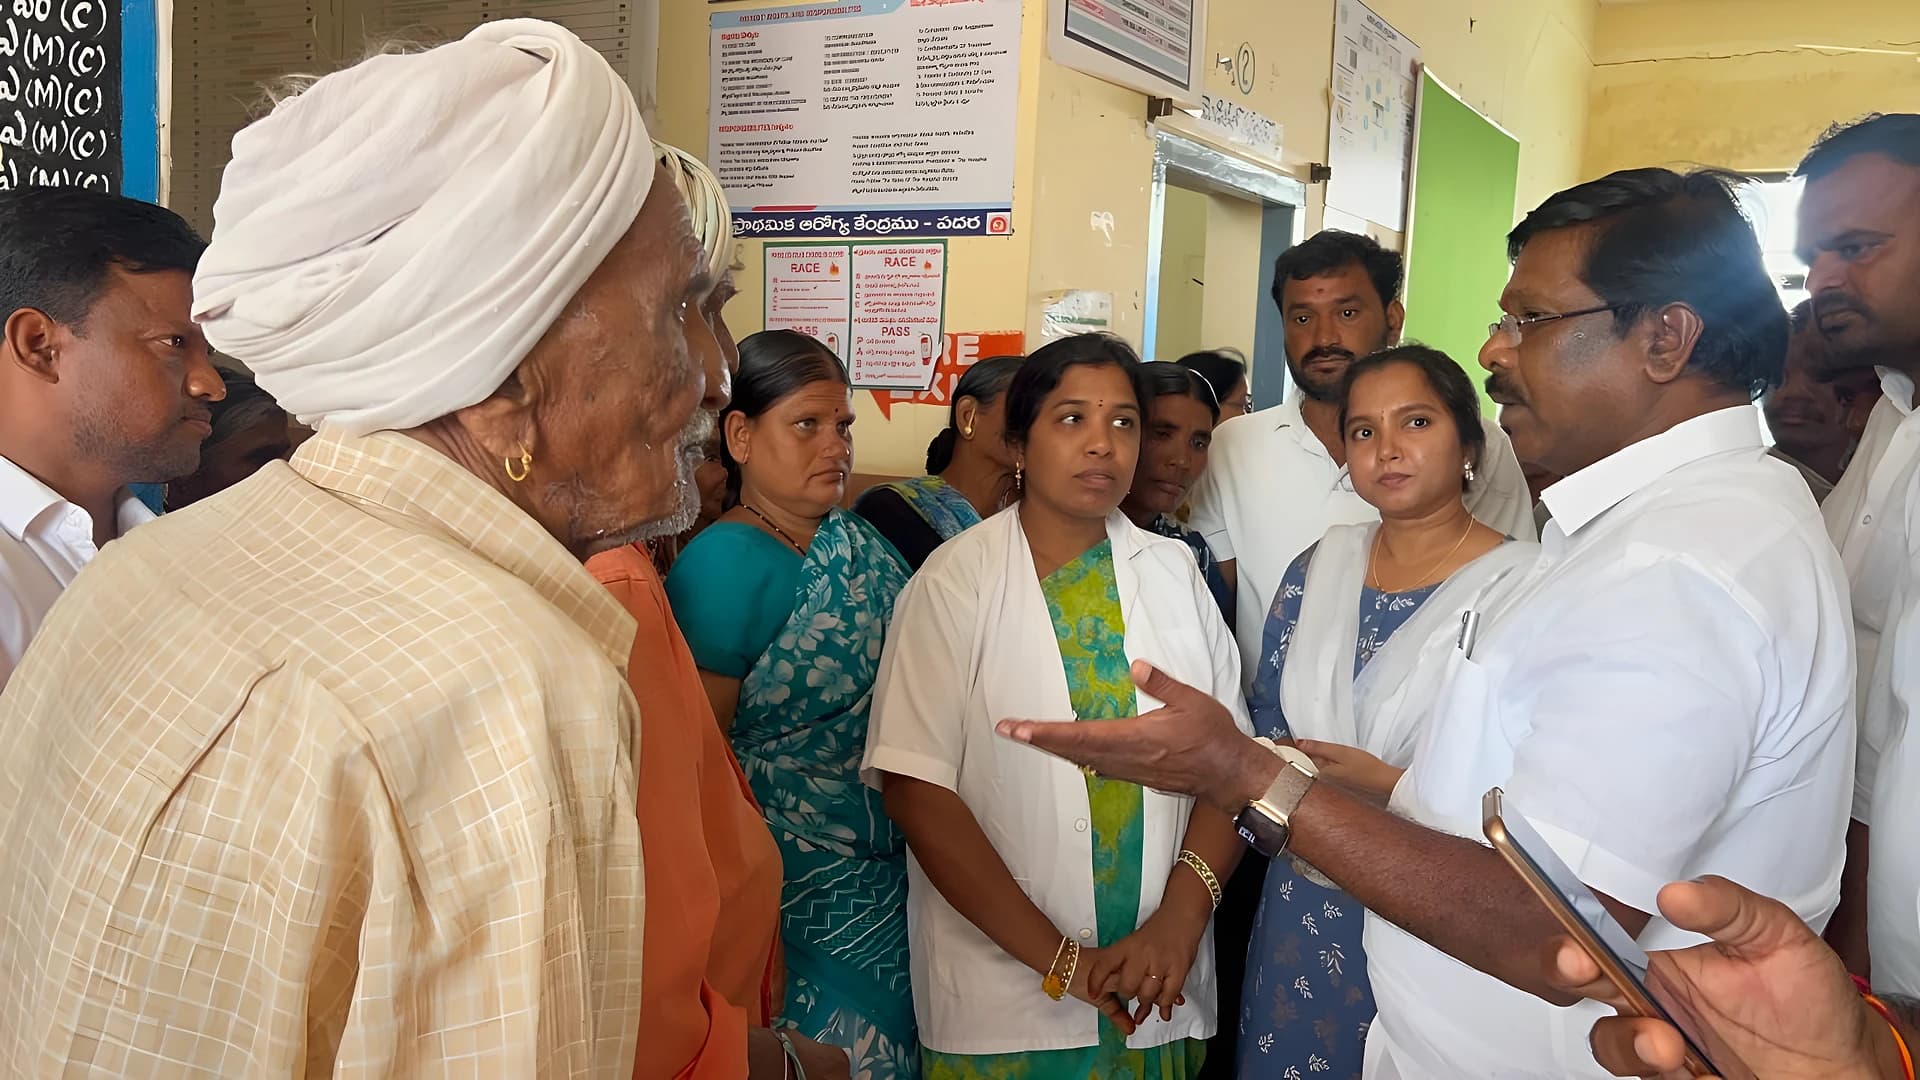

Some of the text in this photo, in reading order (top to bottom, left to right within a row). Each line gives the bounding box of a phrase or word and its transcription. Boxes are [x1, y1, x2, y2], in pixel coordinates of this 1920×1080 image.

[853, 214, 919, 234] కేంద్రము
[936, 216, 981, 230] పదర
[884, 256, 917, 267] RACE
[790, 262, 820, 273] RACE
[881, 326, 911, 337] PASS
